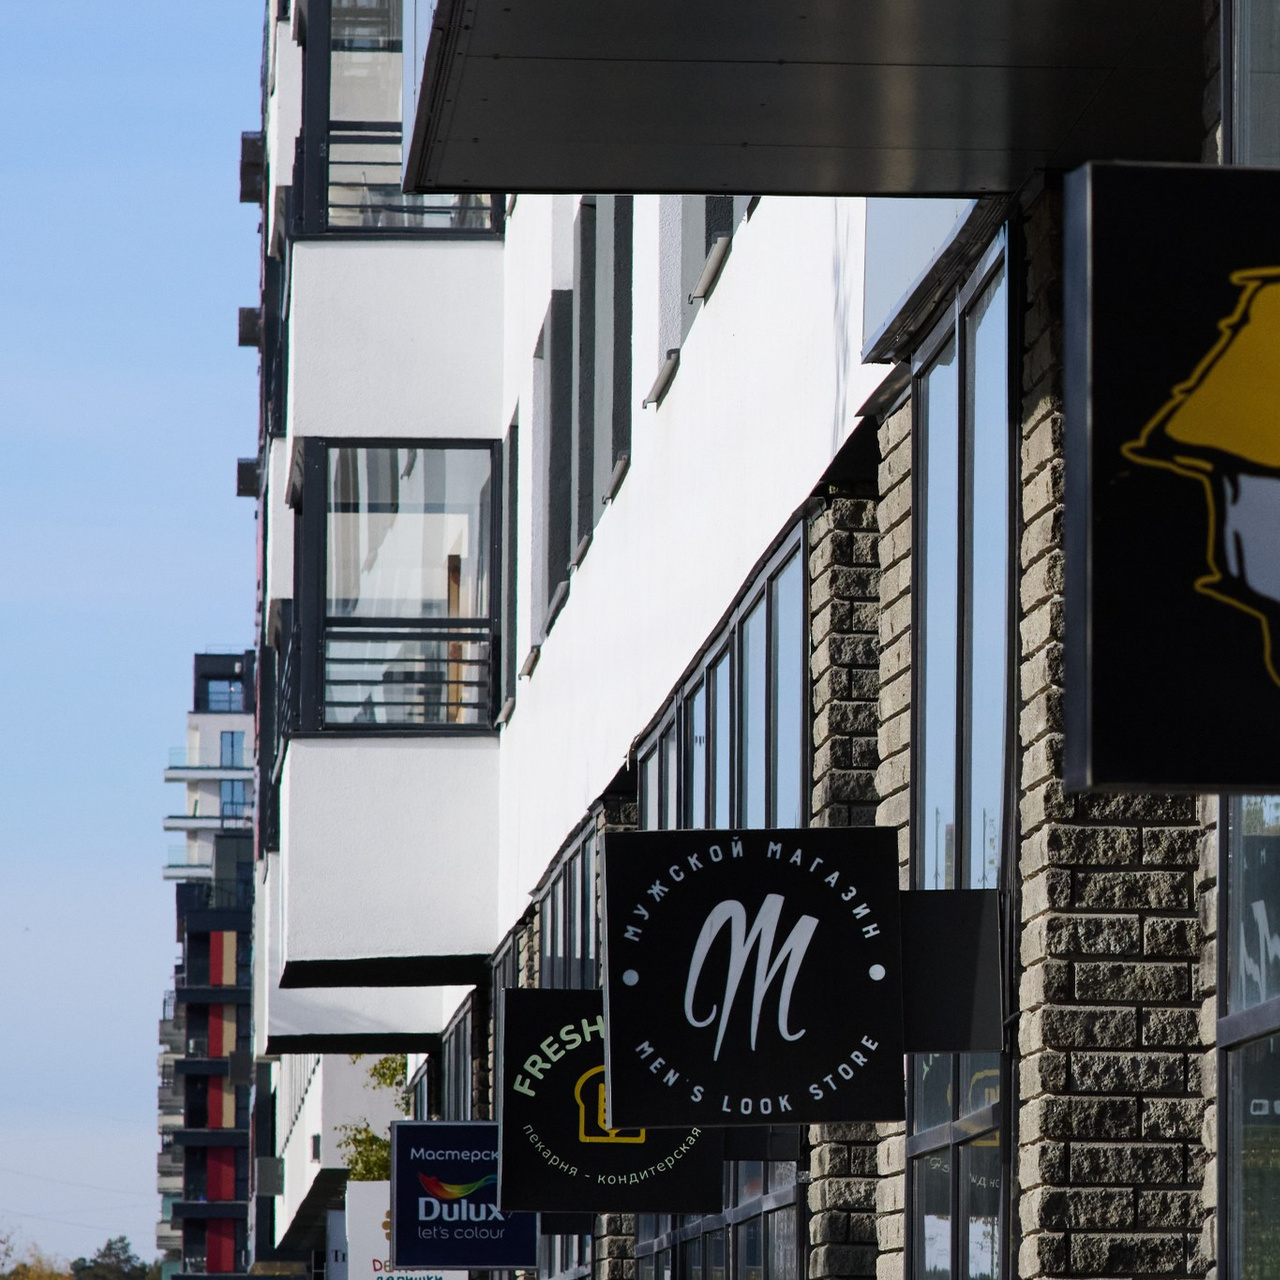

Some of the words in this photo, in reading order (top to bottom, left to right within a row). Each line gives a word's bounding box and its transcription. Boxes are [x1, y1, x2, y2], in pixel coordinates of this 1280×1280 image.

[624, 836, 743, 942] МУЖСКОЙ
[767, 841, 881, 939] МАГАЗИН
[513, 1015, 605, 1097] FRESH
[636, 1040, 705, 1104] MEN'S
[722, 1094, 792, 1115] LOOK
[808, 1035, 879, 1100] STORE
[410, 1147, 498, 1163] Мастерск
[523, 1124, 578, 1177] пекарня
[597, 1127, 702, 1185] кондитерская
[418, 1197, 505, 1222] Dulux
[418, 1226, 450, 1239] let's
[453, 1226, 505, 1239] colour
